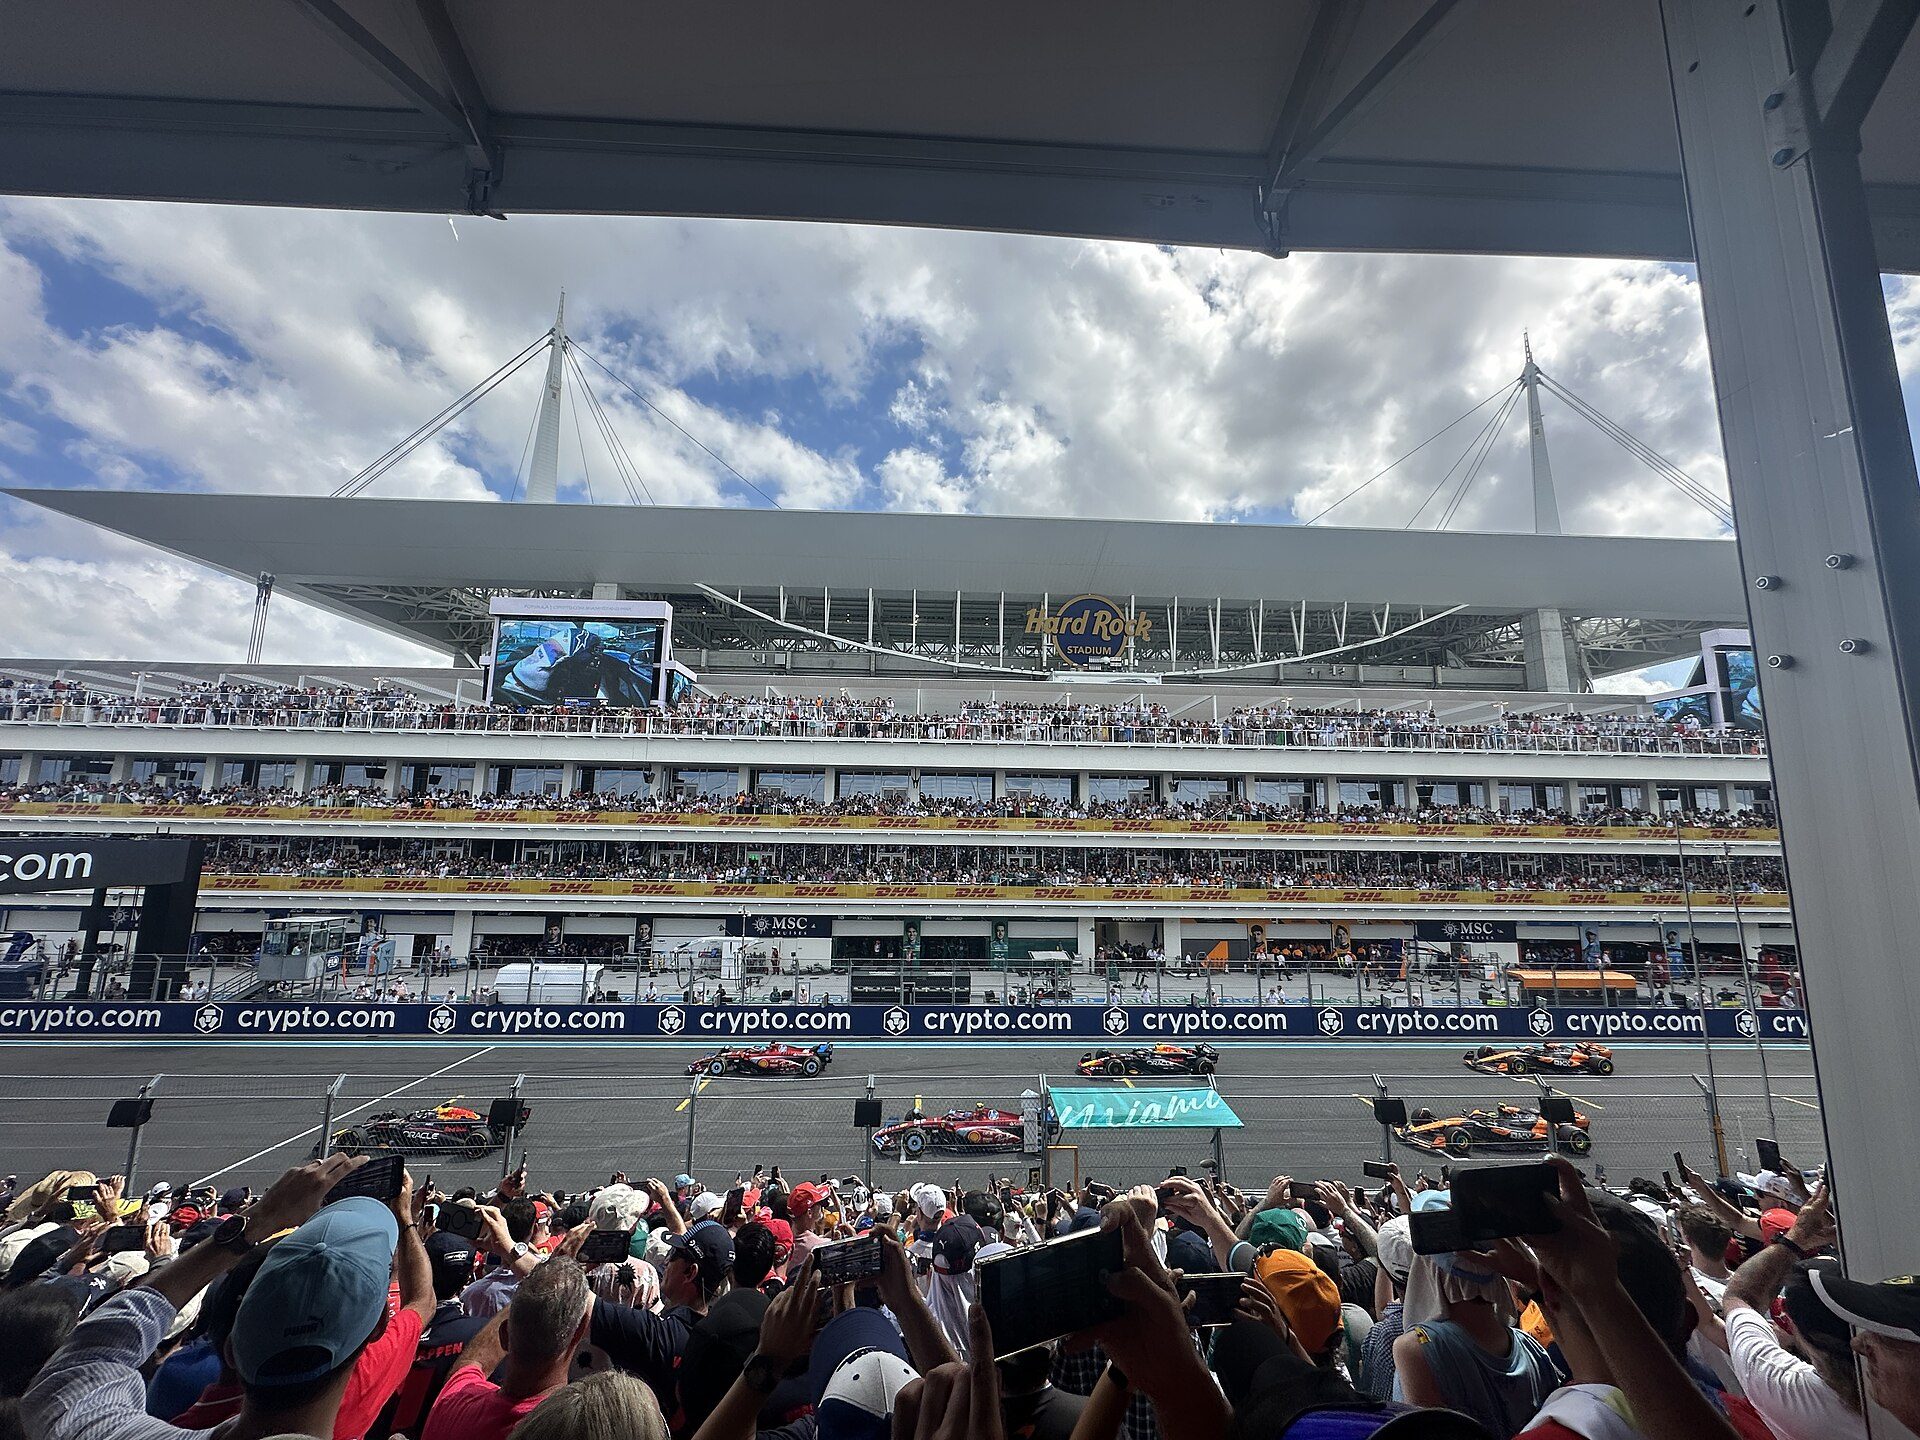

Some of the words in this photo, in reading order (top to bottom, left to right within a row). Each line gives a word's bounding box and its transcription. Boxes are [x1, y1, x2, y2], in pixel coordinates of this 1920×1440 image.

[1025, 608, 1089, 634] Hard
[1092, 610, 1153, 642] Rock
[1066, 645, 1112, 655] STADIUM
[55, 805, 103, 814] DHL
[141, 806, 188, 816] DHL
[224, 807, 271, 818] DHL
[308, 808, 355, 818] DHL
[390, 810, 438, 820] DHL
[473, 812, 520, 822] DHL
[555, 812, 601, 822] DHL
[636, 814, 682, 824] DHL
[718, 816, 763, 826] DHL
[798, 816, 844, 826] DHL
[877, 818, 922, 828] DHL
[956, 819, 1000, 828] DHL
[1034, 820, 1078, 830] DHL
[1112, 821, 1154, 831] DHL
[1189, 822, 1231, 832] DHL
[1266, 823, 1308, 833] DHL
[1342, 824, 1384, 834] DHL
[1416, 825, 1458, 836] DHL
[1490, 826, 1531, 836] DHL
[1564, 828, 1605, 838] DHL
[1638, 828, 1677, 838] DHL
[1710, 830, 1750, 839] DHL
[214, 879, 261, 888] DHL
[300, 880, 345, 890] DHL
[382, 881, 429, 891] DHL
[466, 882, 513, 892] DHL
[549, 883, 595, 893] DHL
[631, 884, 677, 894] DHL
[713, 885, 759, 895] DHL
[794, 886, 839, 896] DHL
[875, 887, 920, 897] DHL
[954, 888, 1000, 898] DHL
[1034, 888, 1077, 898] DHL
[1112, 889, 1154, 900] DHL
[1190, 890, 1231, 900] DHL
[1267, 891, 1308, 901] DHL
[1343, 892, 1385, 902] DHL
[1417, 892, 1460, 902] DHL
[1494, 894, 1534, 903] DHL
[1568, 894, 1609, 904] DHL
[1642, 895, 1681, 905] DHL
[1715, 896, 1754, 906] DHL
[772, 916, 808, 930] MSC
[1460, 922, 1493, 934] MSC
[0, 1006, 162, 1030] crypto.com
[238, 1007, 394, 1032] crypto.com
[470, 1008, 625, 1032] crypto.com
[700, 1009, 850, 1032] crypto.com
[924, 1010, 1072, 1034] crypto.com
[1143, 1010, 1287, 1034] crypto.com
[1357, 1011, 1498, 1035] crypto.com
[1566, 1012, 1703, 1036] crypto.com
[403, 1131, 440, 1140] ORACLE
